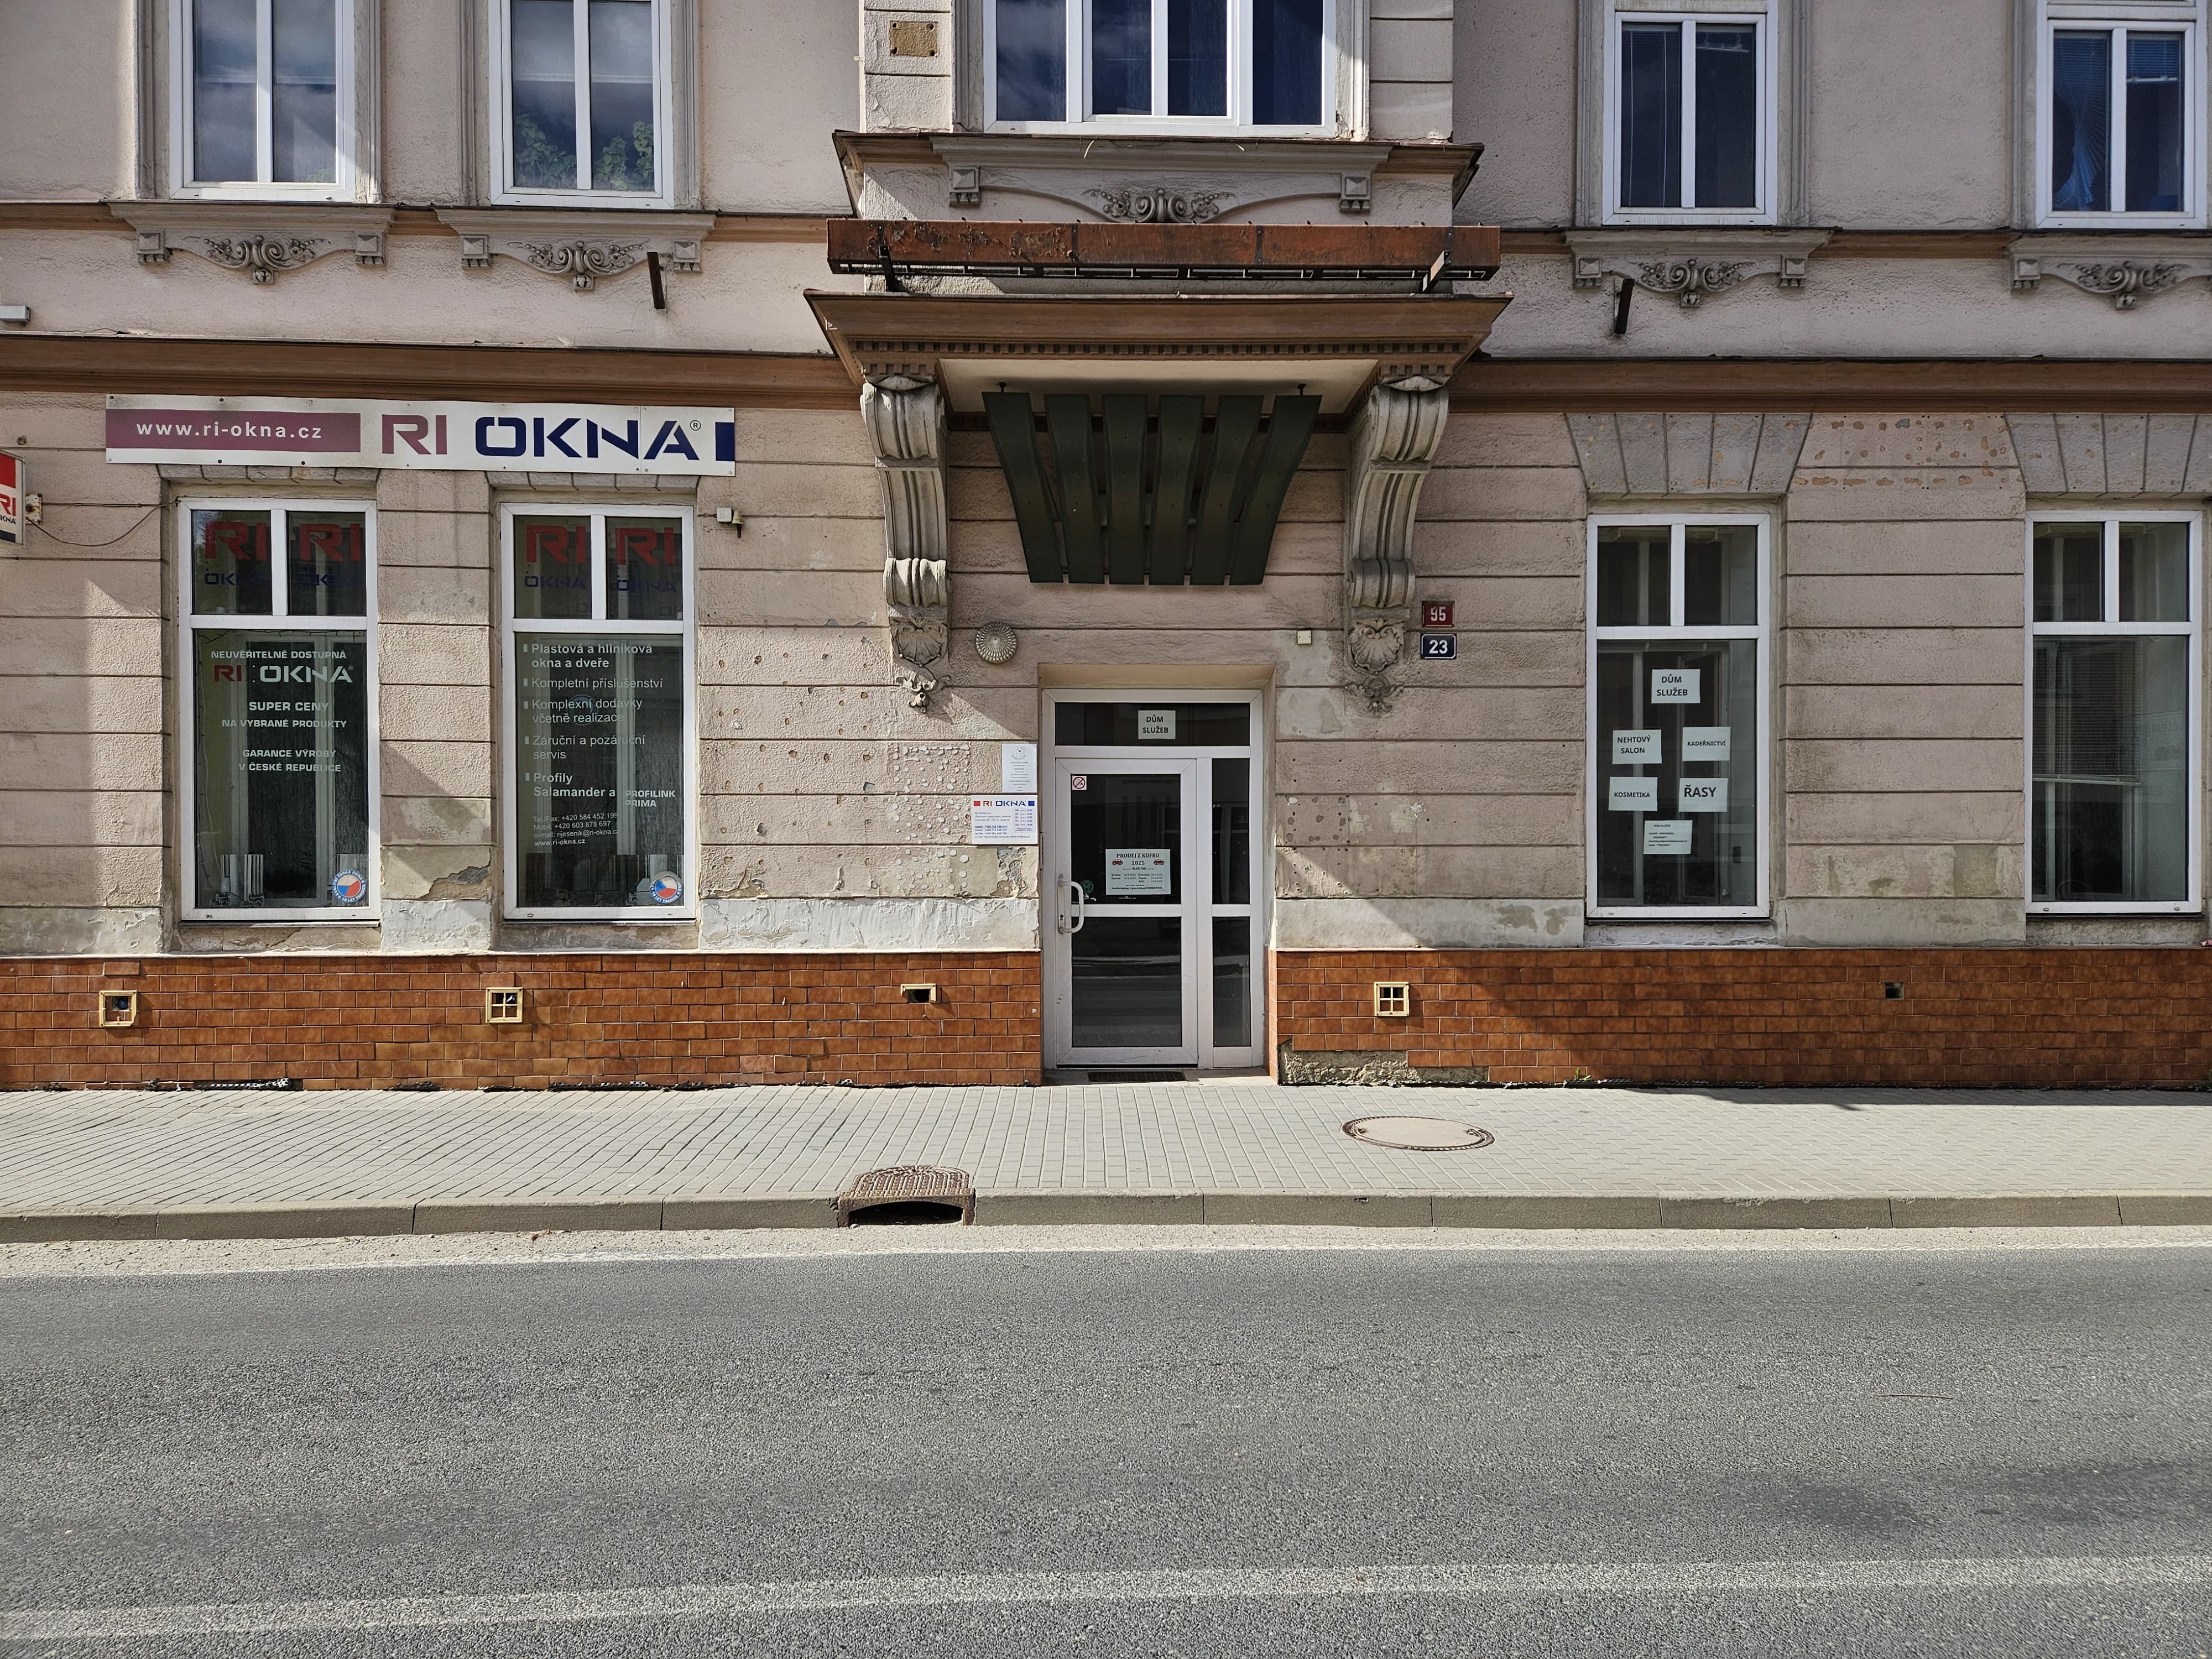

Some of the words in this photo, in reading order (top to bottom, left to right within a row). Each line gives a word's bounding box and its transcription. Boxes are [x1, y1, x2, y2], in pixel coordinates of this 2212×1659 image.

[136, 420, 322, 440] www.ri-okna.cz
[382, 414, 447, 455] RI
[0, 514, 17, 525] KNA
[205, 521, 267, 561] RI
[300, 523, 362, 562] RI
[526, 525, 586, 564] RI
[615, 527, 676, 566] RI
[525, 576, 586, 589] OKNA
[1431, 606, 1446, 622] 95
[531, 643, 584, 654] Plastová
[598, 643, 653, 654] hliníková
[1429, 639, 1448, 654] 23
[211, 649, 288, 659] NEUVĚŘITELNĚ
[291, 649, 347, 660] DOSTUPNÁ
[532, 658, 561, 668] okna
[576, 658, 609, 668] dveře
[215, 665, 242, 682] RI
[1661, 674, 1682, 684] DŮM
[531, 678, 589, 690] Kompletní
[592, 678, 664, 691] příslušenství
[1657, 686, 1688, 697] SLUŽEB
[249, 702, 291, 711] SUPER
[295, 702, 330, 711] CENY
[532, 700, 592, 711] Komplexní
[596, 698, 643, 710] dodávky
[241, 718, 289, 728] VYBRANÉ
[293, 720, 347, 728] PRODUKTY
[533, 713, 570, 723] včetně
[573, 713, 624, 723] realizace
[1146, 714, 1164, 723] DŮM
[1142, 726, 1168, 734] SLUŽEB
[533, 735, 576, 745] Záruční
[590, 734, 645, 747] pozáruční
[1617, 734, 1651, 743] NEHTOVÝ
[243, 749, 292, 758] GARANCE
[295, 748, 336, 758] VÝROBY
[533, 749, 566, 759] servis
[249, 761, 282, 771] ČESKÉ
[285, 764, 341, 772] REPUBLICE
[534, 773, 573, 785] Profily
[534, 787, 604, 797] Salamander
[1684, 784, 1717, 797] ŘASY
